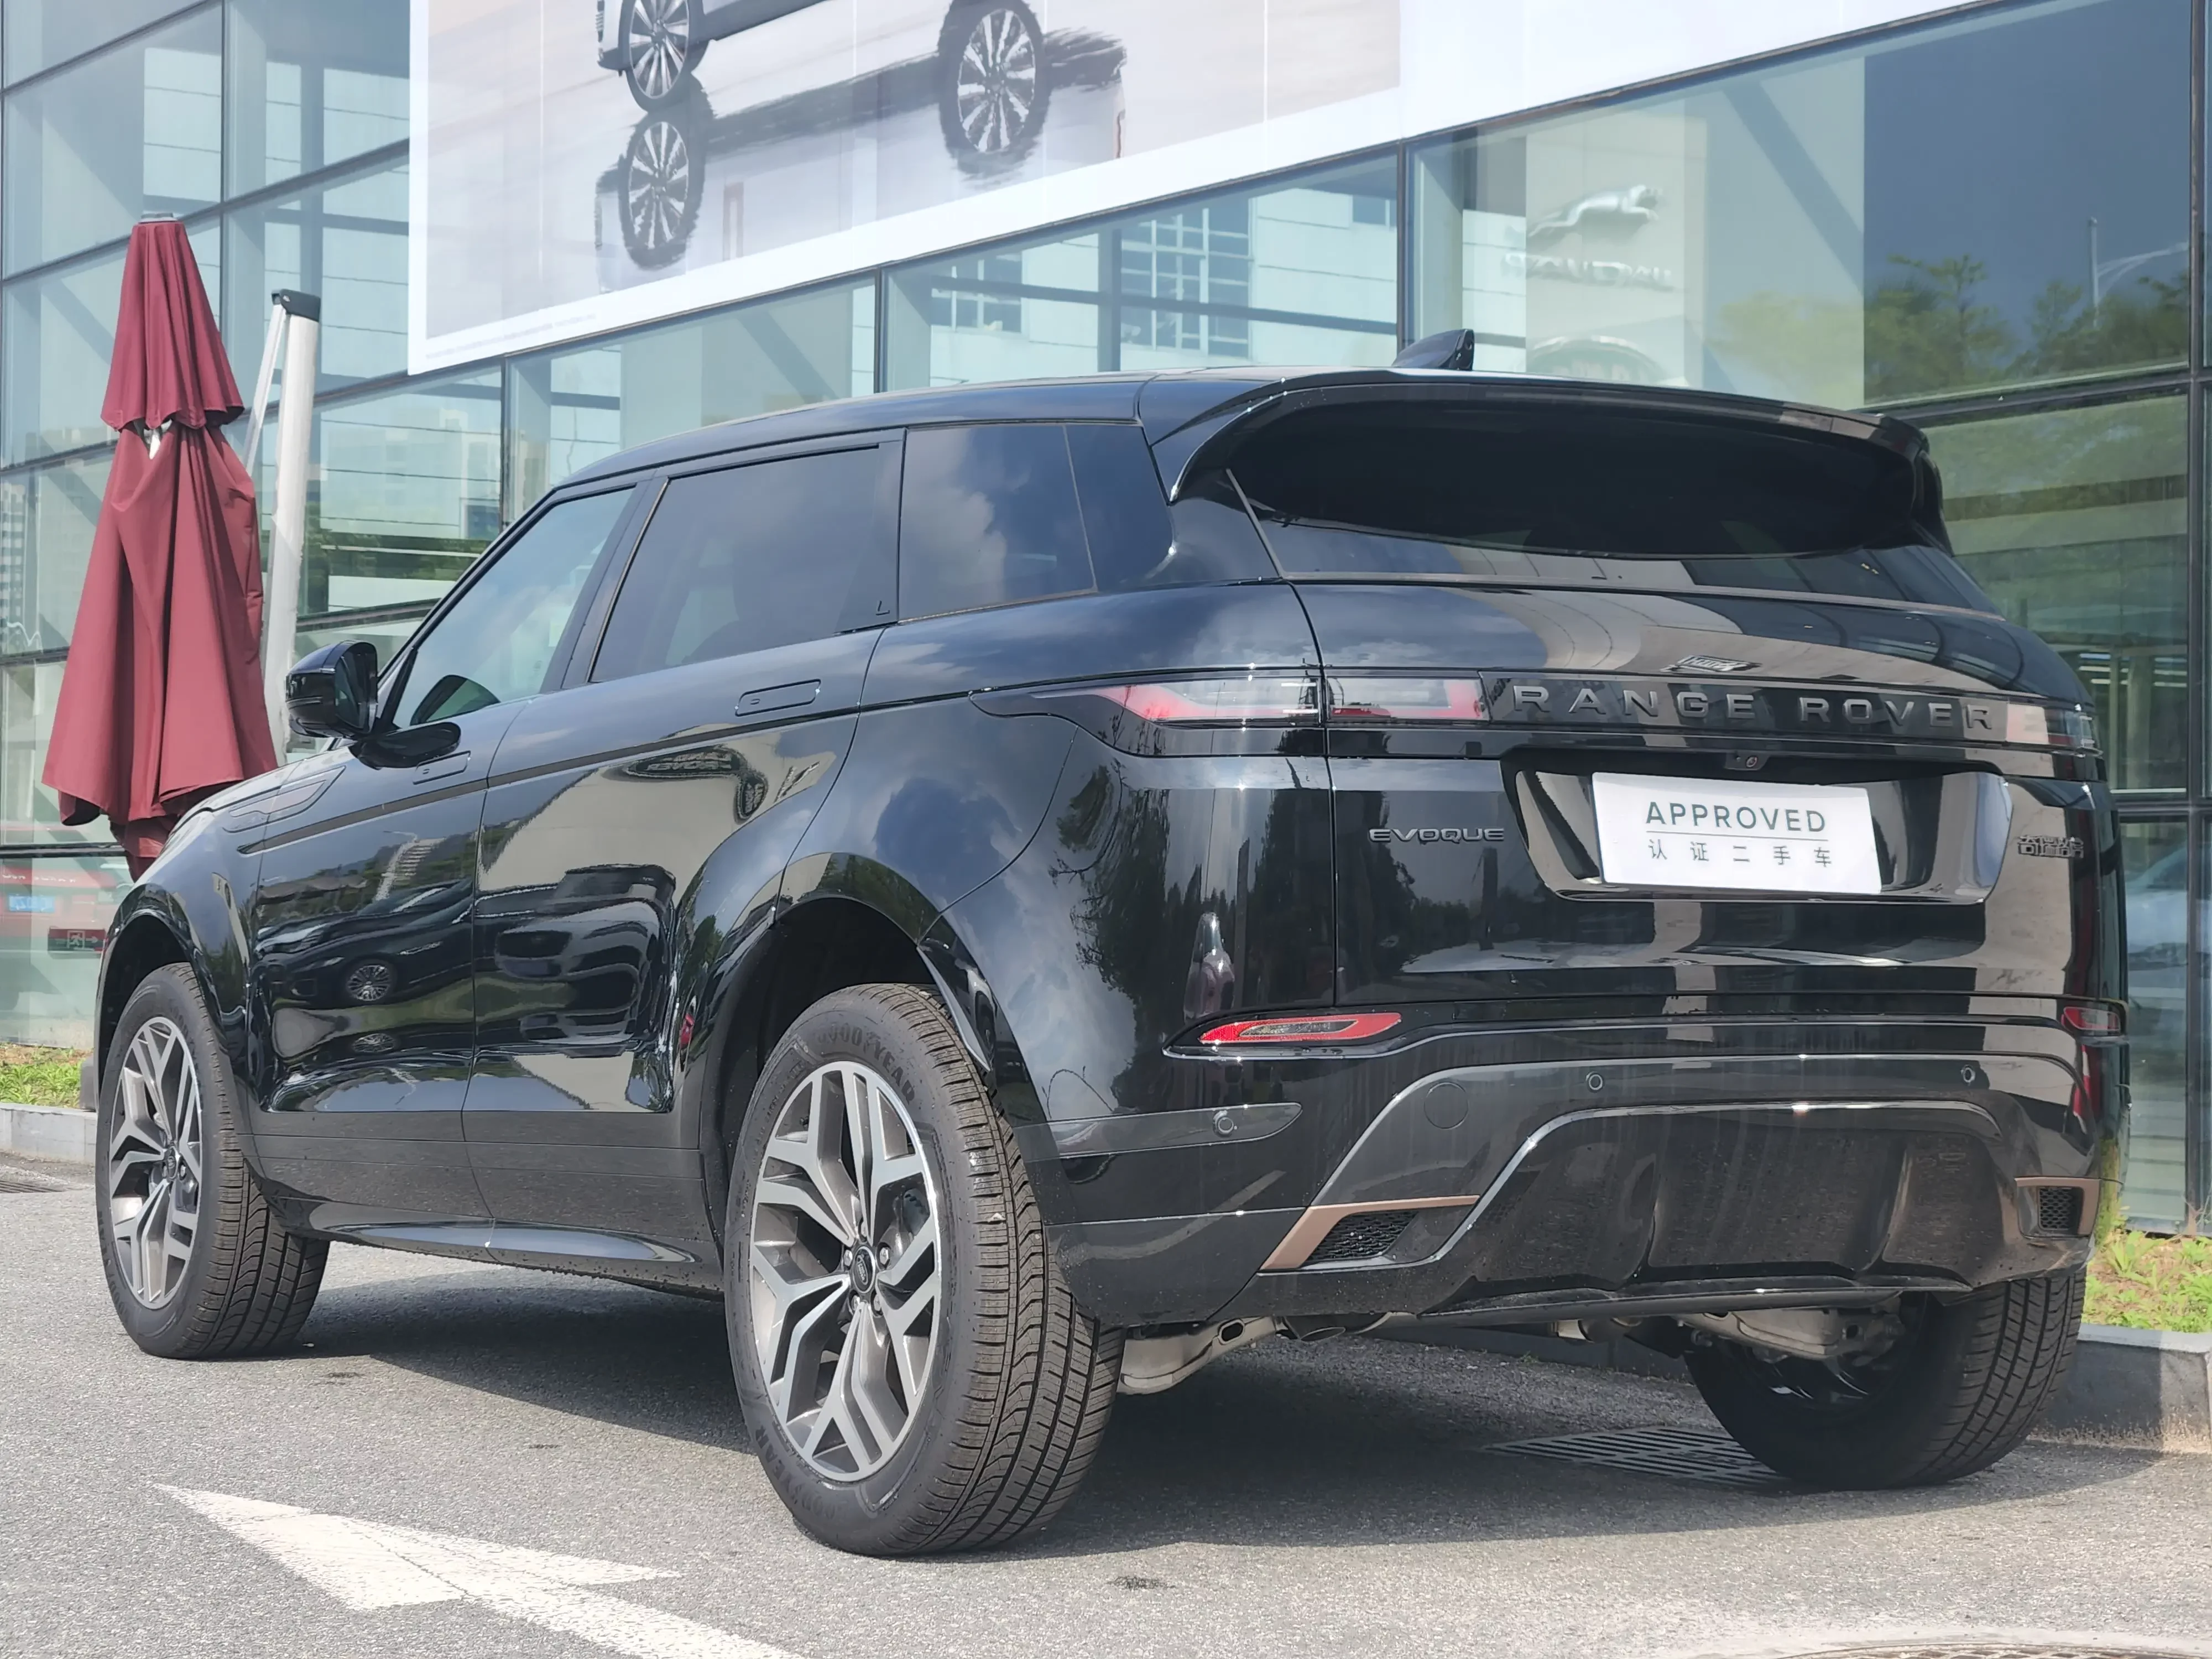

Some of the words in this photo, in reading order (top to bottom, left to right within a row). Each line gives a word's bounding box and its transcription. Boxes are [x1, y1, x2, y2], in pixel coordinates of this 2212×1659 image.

[1512, 685, 1757, 719] RANGE
[1799, 696, 1992, 730] ROVER
[1646, 801, 1825, 832] APPROVED
[1369, 828, 1505, 844] EVOQUE
[1648, 839, 1831, 867] 认证二手车
